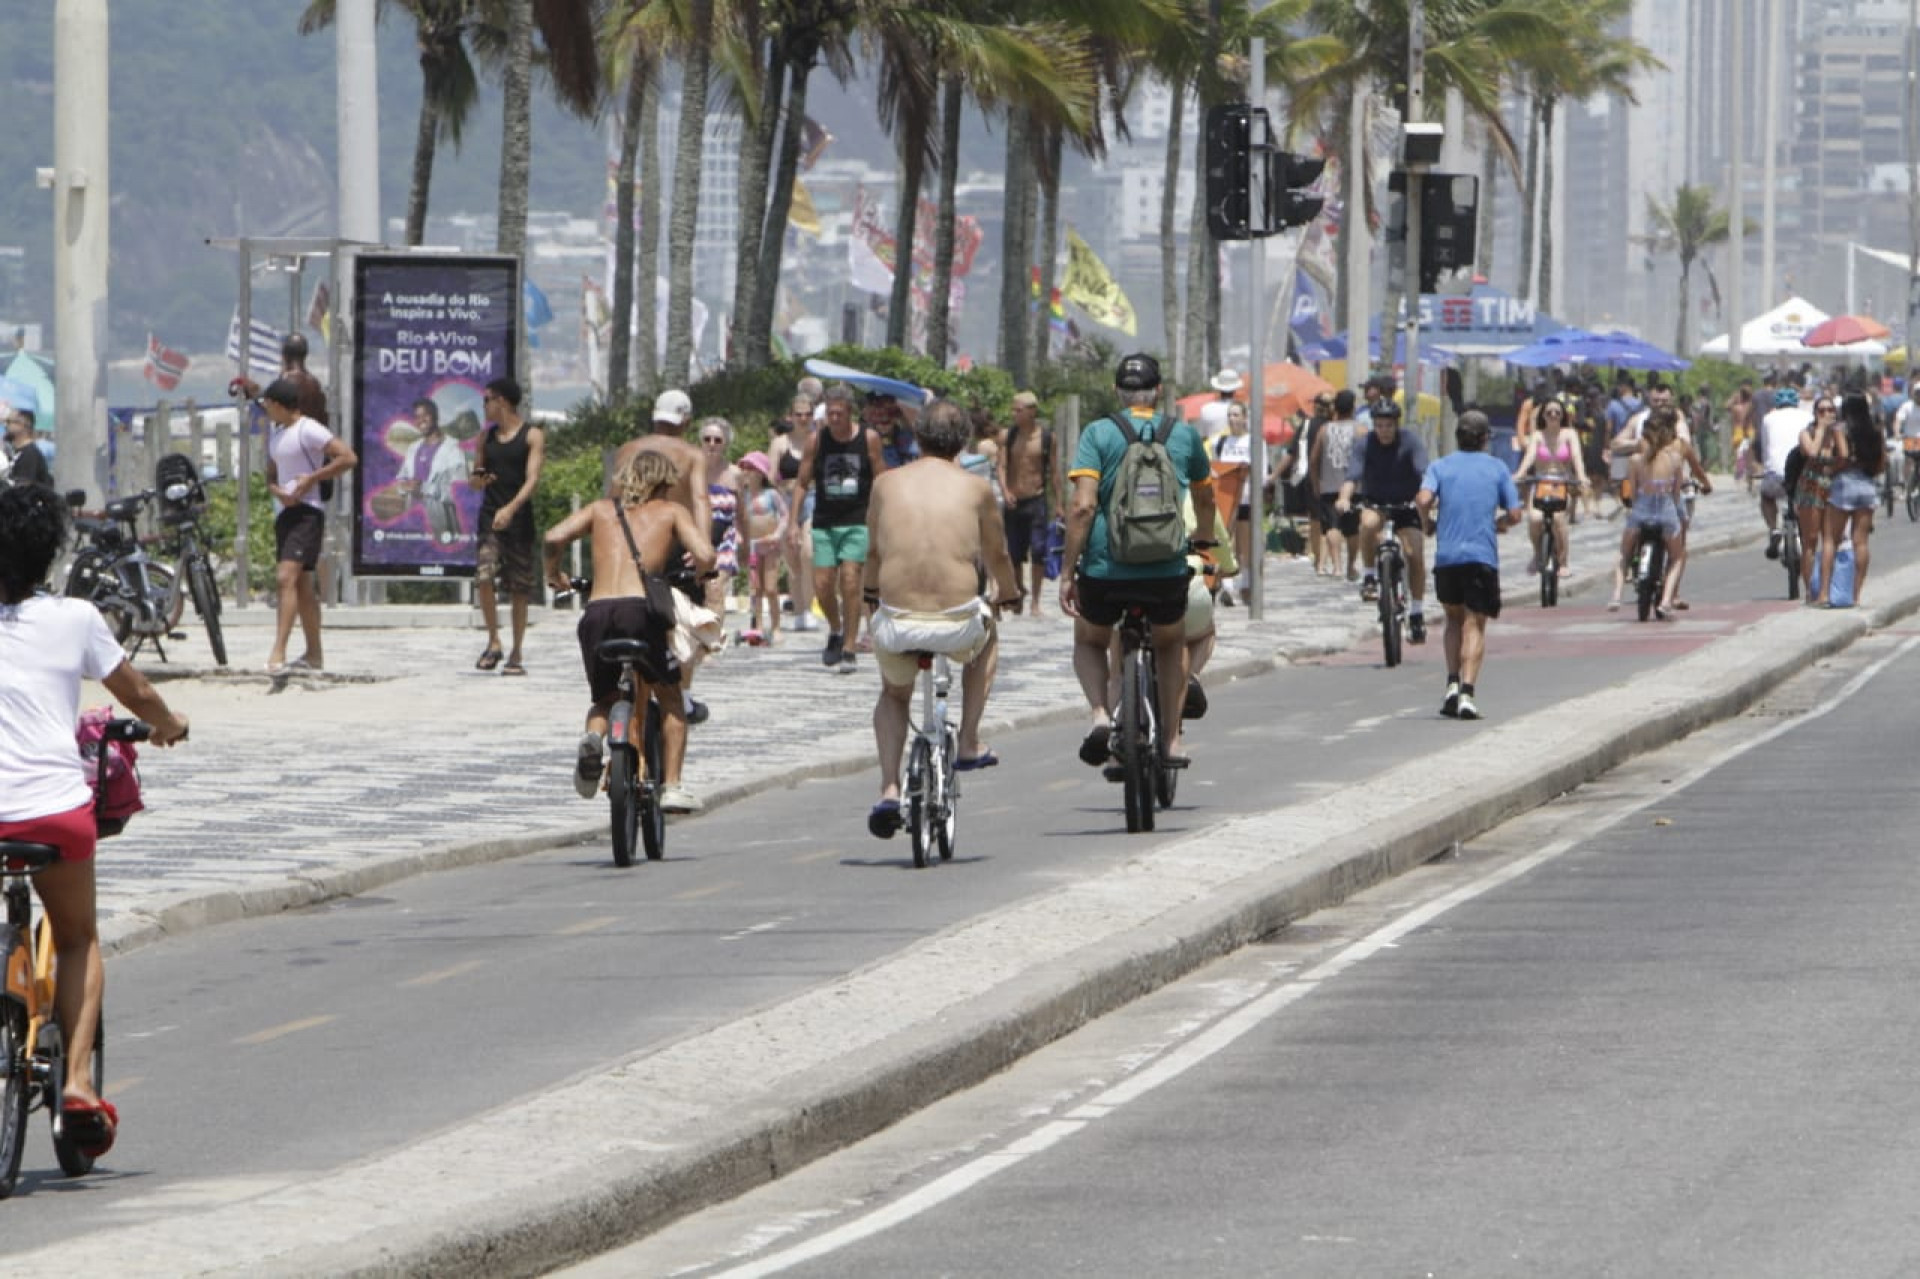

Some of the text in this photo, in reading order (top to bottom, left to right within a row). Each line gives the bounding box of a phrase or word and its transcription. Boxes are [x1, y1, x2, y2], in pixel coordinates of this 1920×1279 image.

[383, 292, 393, 304] A
[449, 293, 465, 305] do
[468, 293, 490, 306] Rio
[1477, 297, 1536, 325] TIM
[379, 348, 493, 375] DEU BOM
